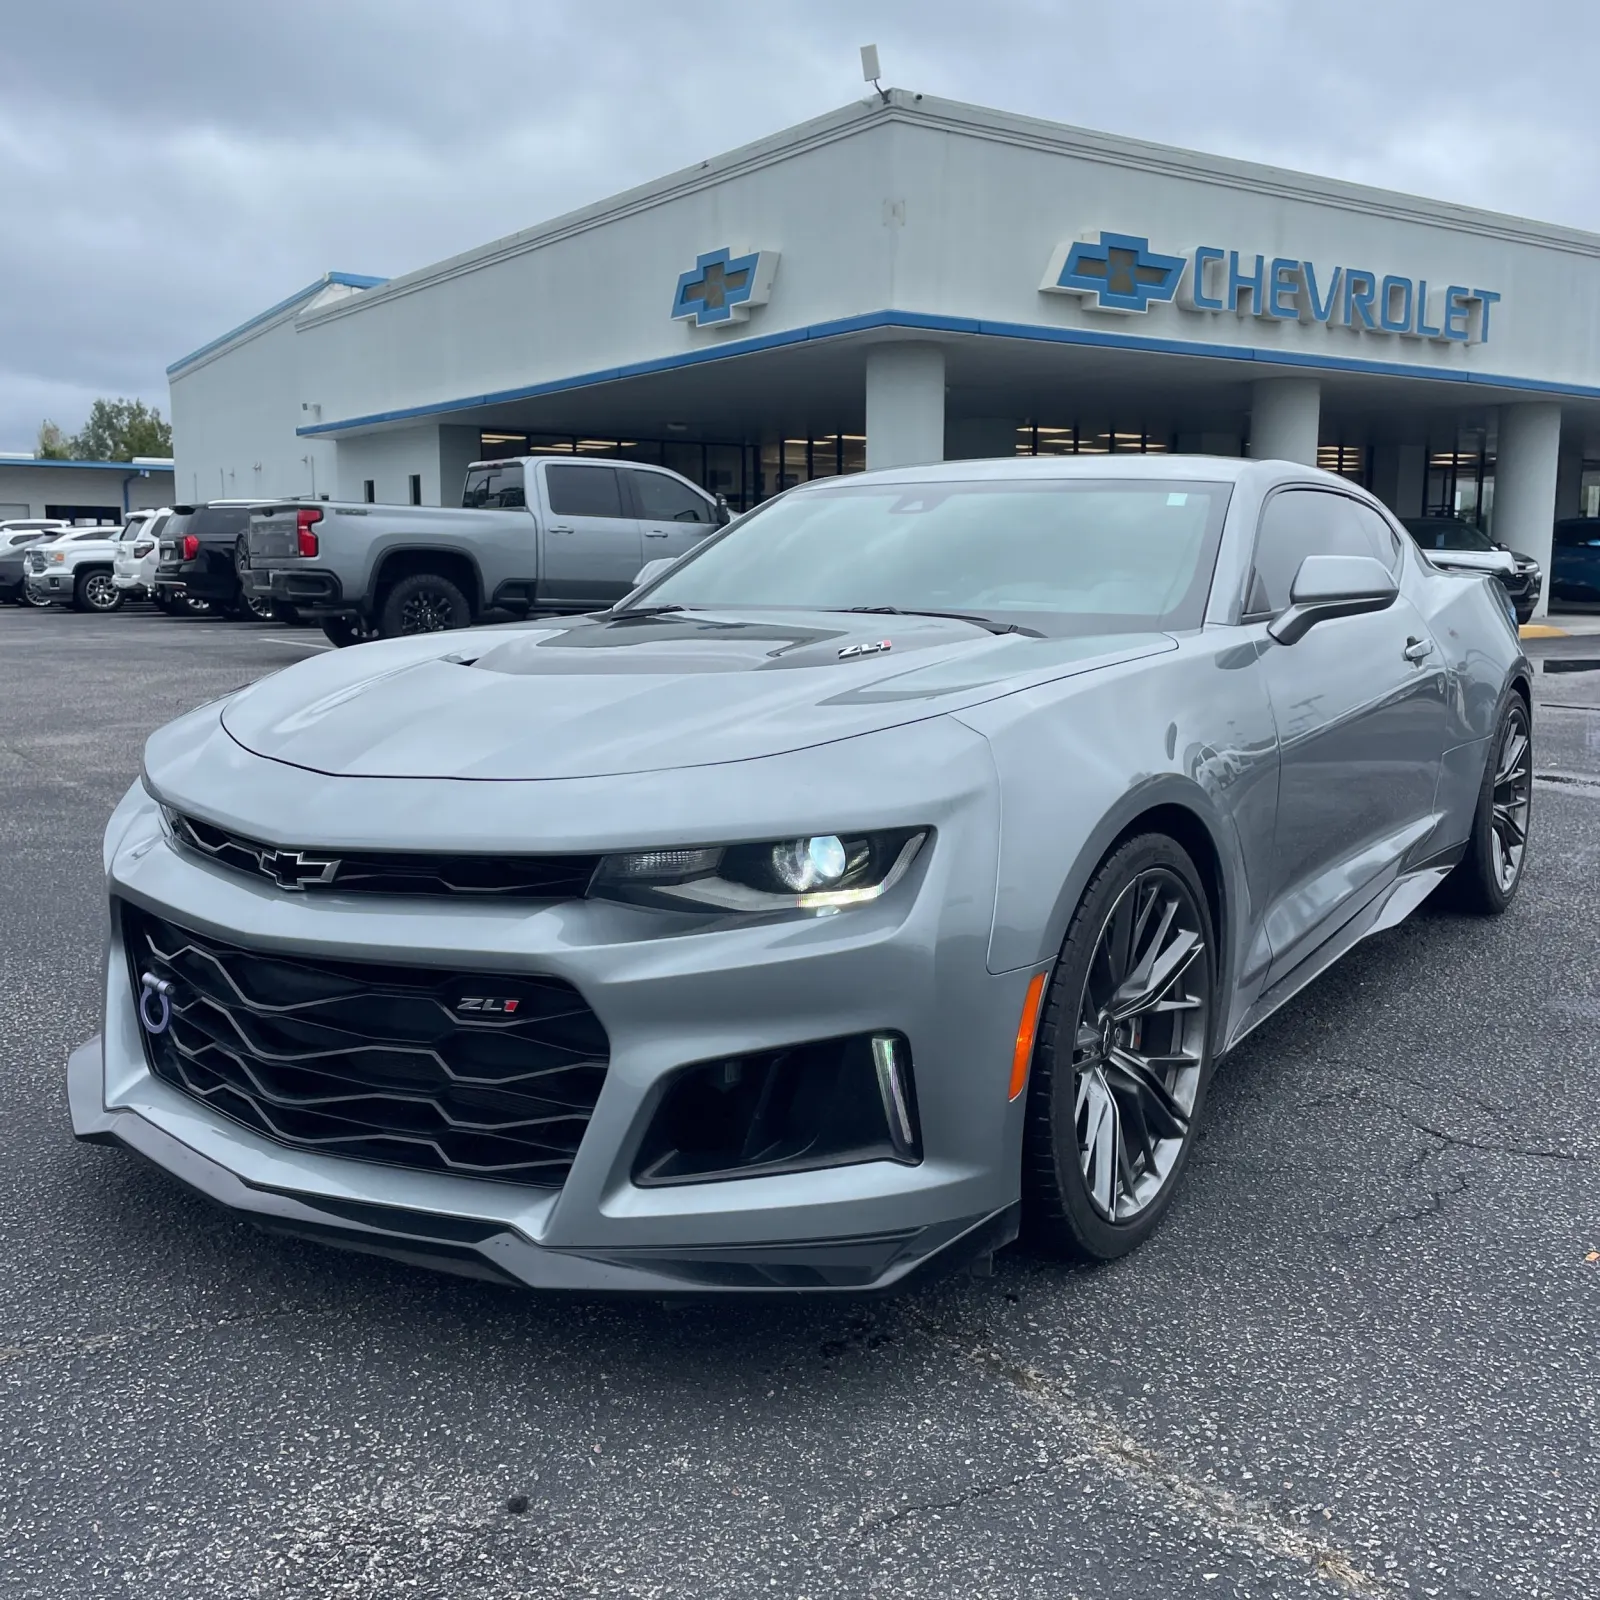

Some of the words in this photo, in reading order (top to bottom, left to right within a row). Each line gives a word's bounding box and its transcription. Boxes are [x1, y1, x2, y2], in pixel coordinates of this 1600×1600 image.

[1194, 245, 1502, 345] CHEVROLET
[838, 640, 892, 660] ZL1
[457, 997, 520, 1013] ZL1
